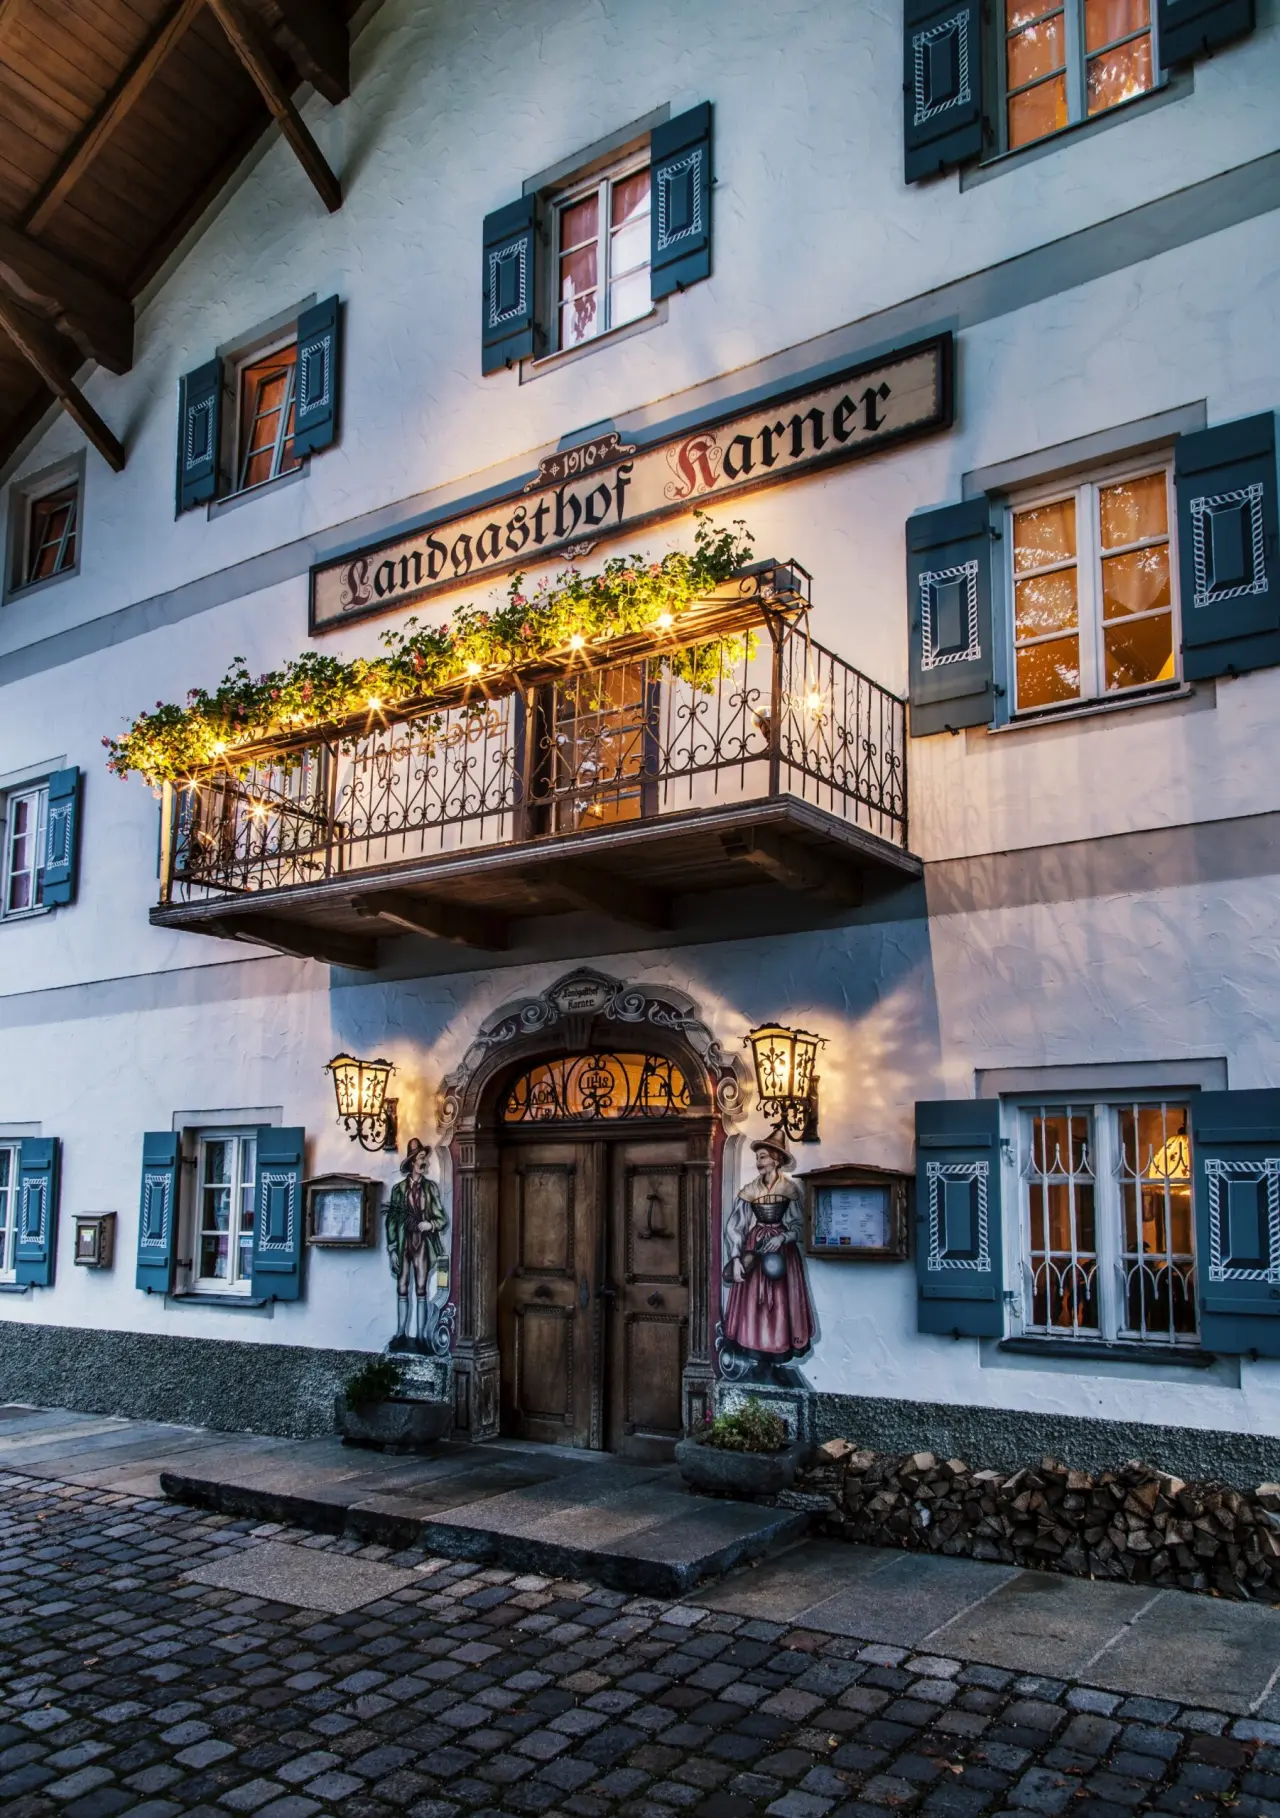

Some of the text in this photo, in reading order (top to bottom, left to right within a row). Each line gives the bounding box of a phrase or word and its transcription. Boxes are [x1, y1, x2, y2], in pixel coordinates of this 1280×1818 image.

[339, 381, 893, 611] Landgasthof Karner
[563, 445, 597, 478] 1910
